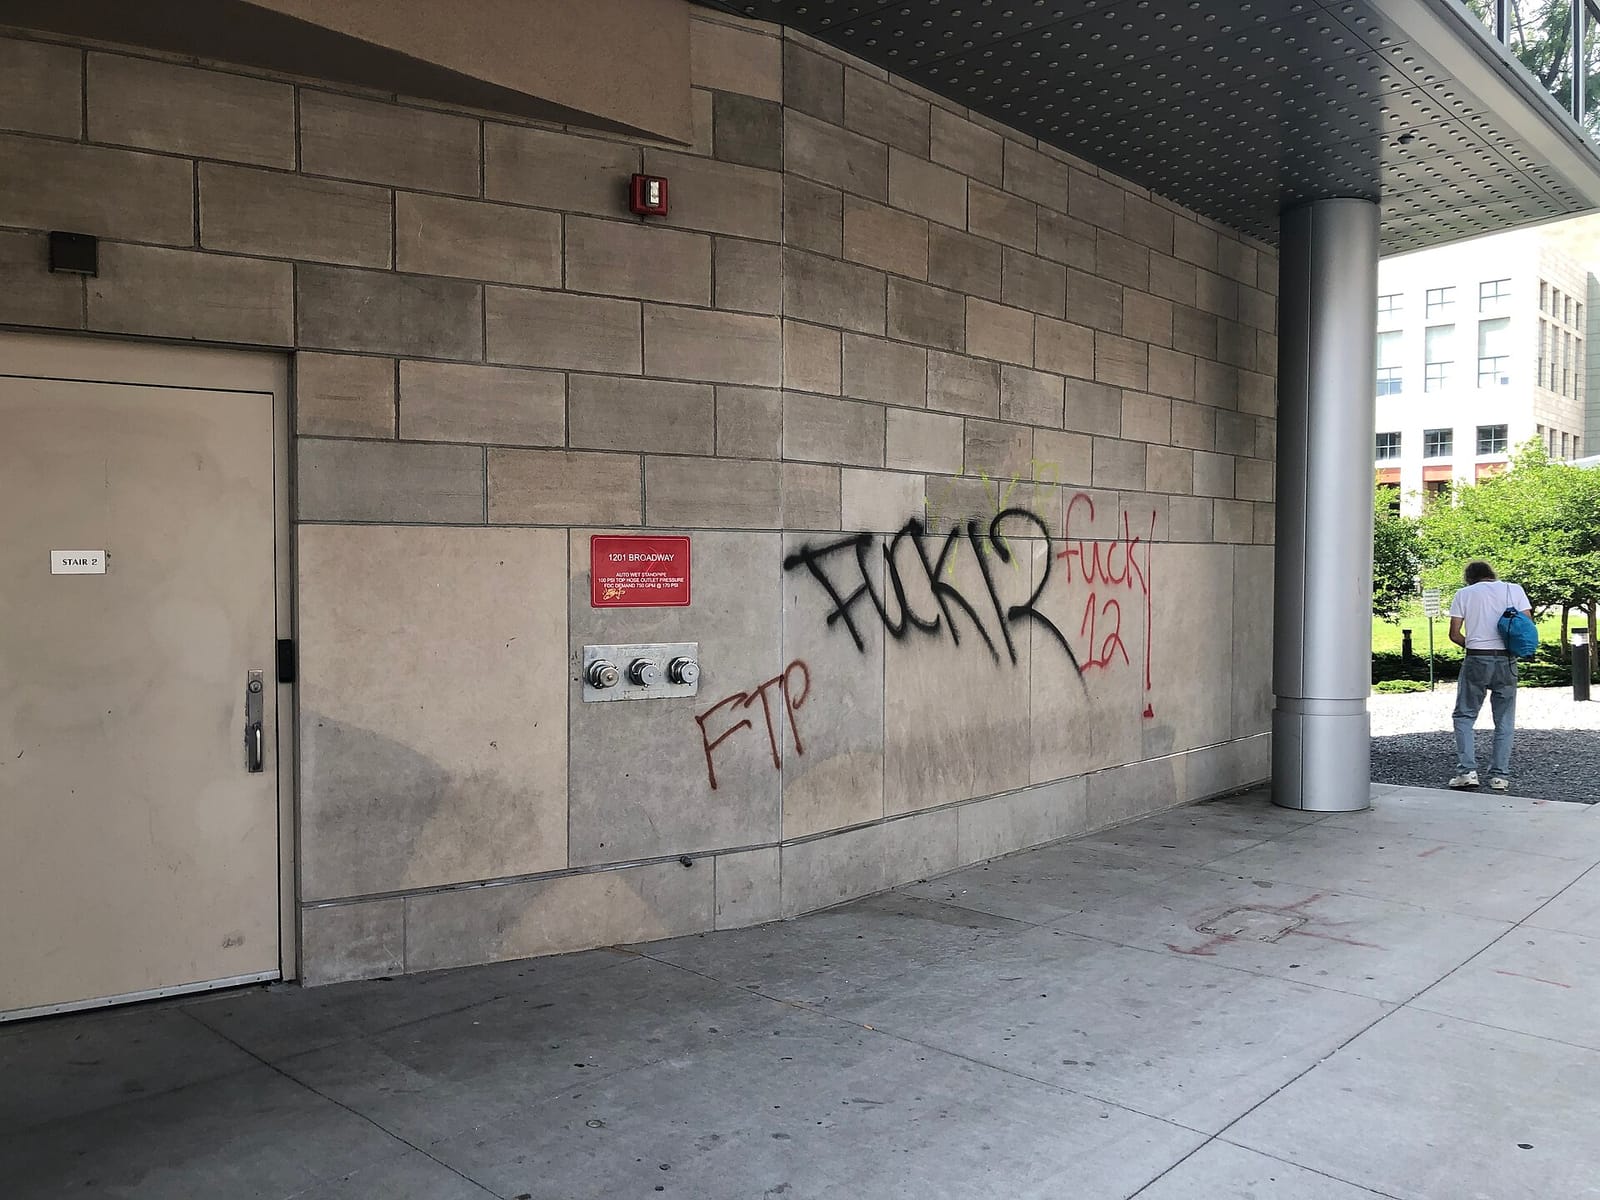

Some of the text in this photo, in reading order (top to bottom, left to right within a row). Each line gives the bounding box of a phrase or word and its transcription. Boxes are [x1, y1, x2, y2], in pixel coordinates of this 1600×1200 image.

[62, 558, 98, 566] STAIR 2
[608, 553, 675, 562] 1201 BROADWAY
[1079, 592, 1130, 674] 12
[694, 659, 811, 790] FTP
